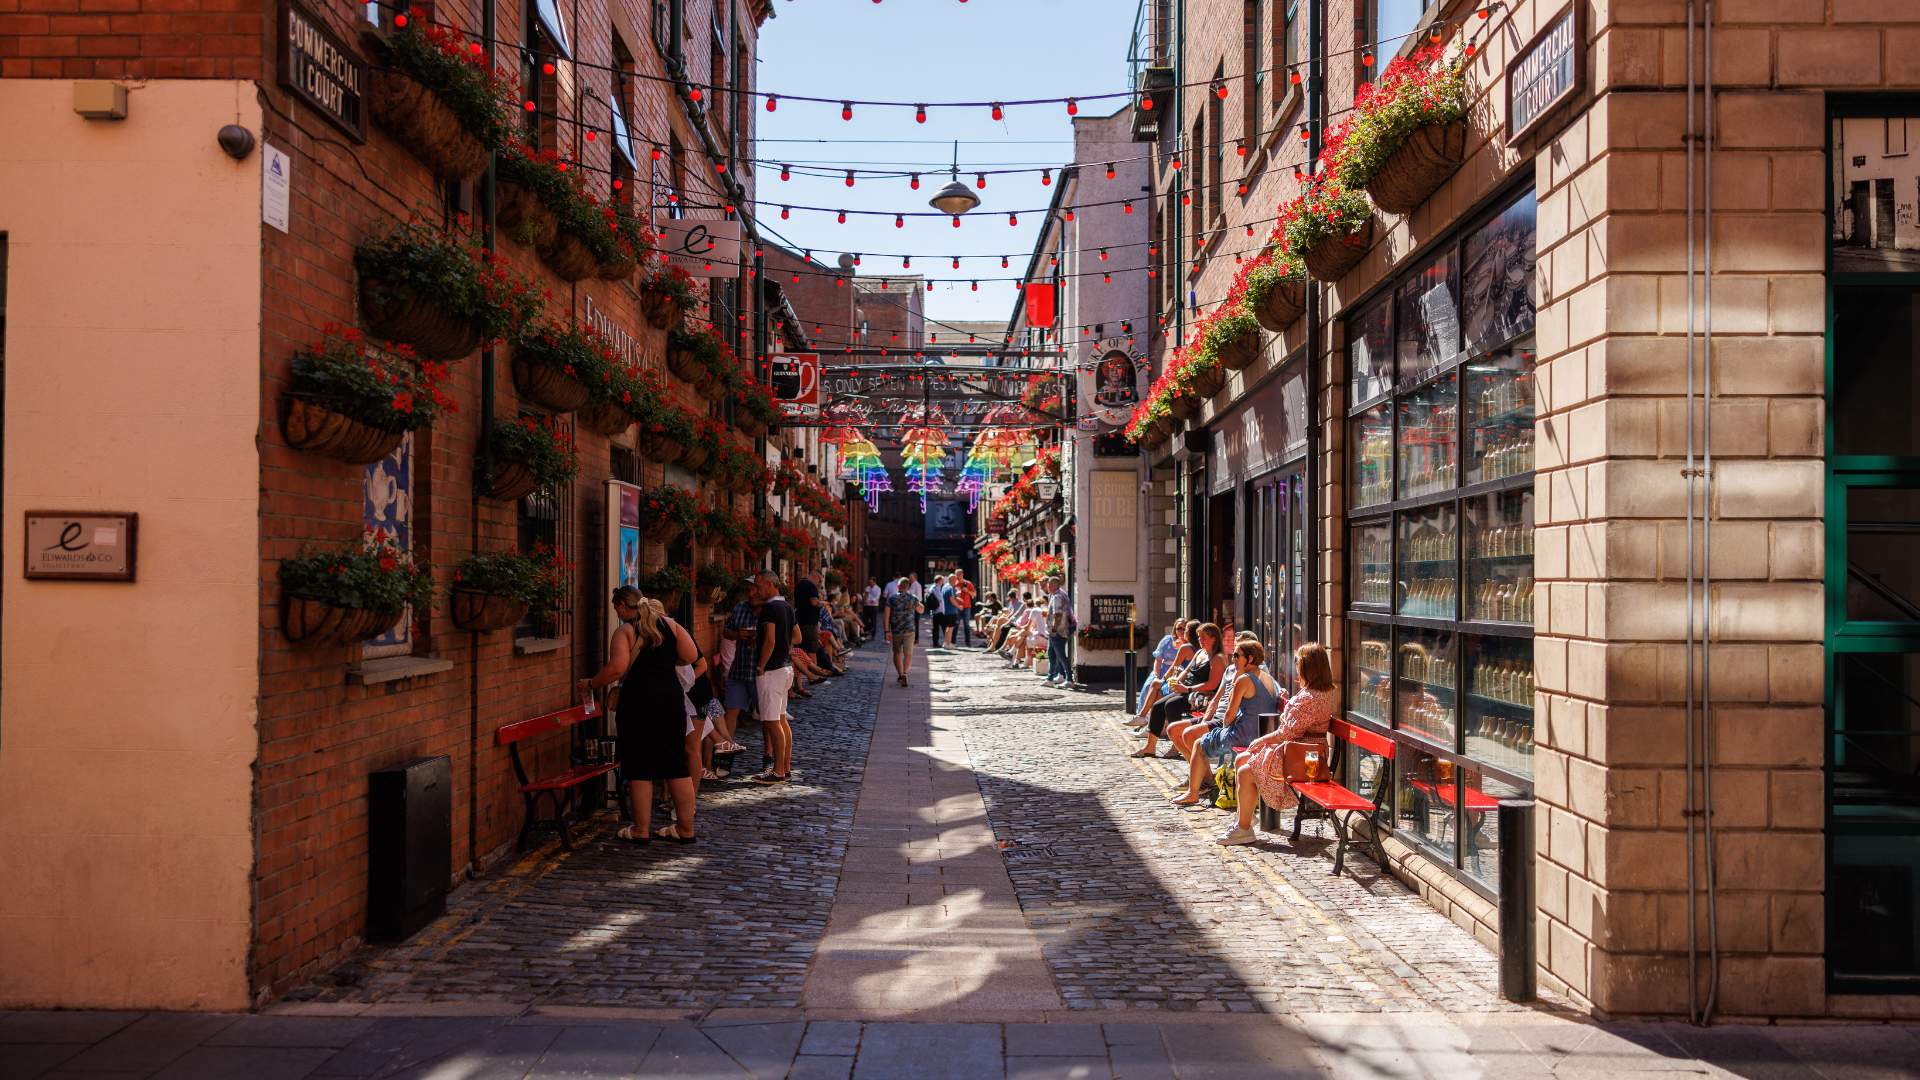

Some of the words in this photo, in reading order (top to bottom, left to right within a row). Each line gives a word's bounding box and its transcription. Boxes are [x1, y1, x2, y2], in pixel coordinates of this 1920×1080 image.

[289, 10, 360, 96] COMMERCIAL
[1511, 14, 1573, 98] COMMERCIAL
[307, 64, 343, 116] COURT
[1526, 65, 1558, 118] COURT
[835, 378, 863, 393] ONLY
[1094, 497, 1113, 516] TO
[1116, 497, 1136, 516] BE
[1098, 606, 1127, 614] SQUARE
